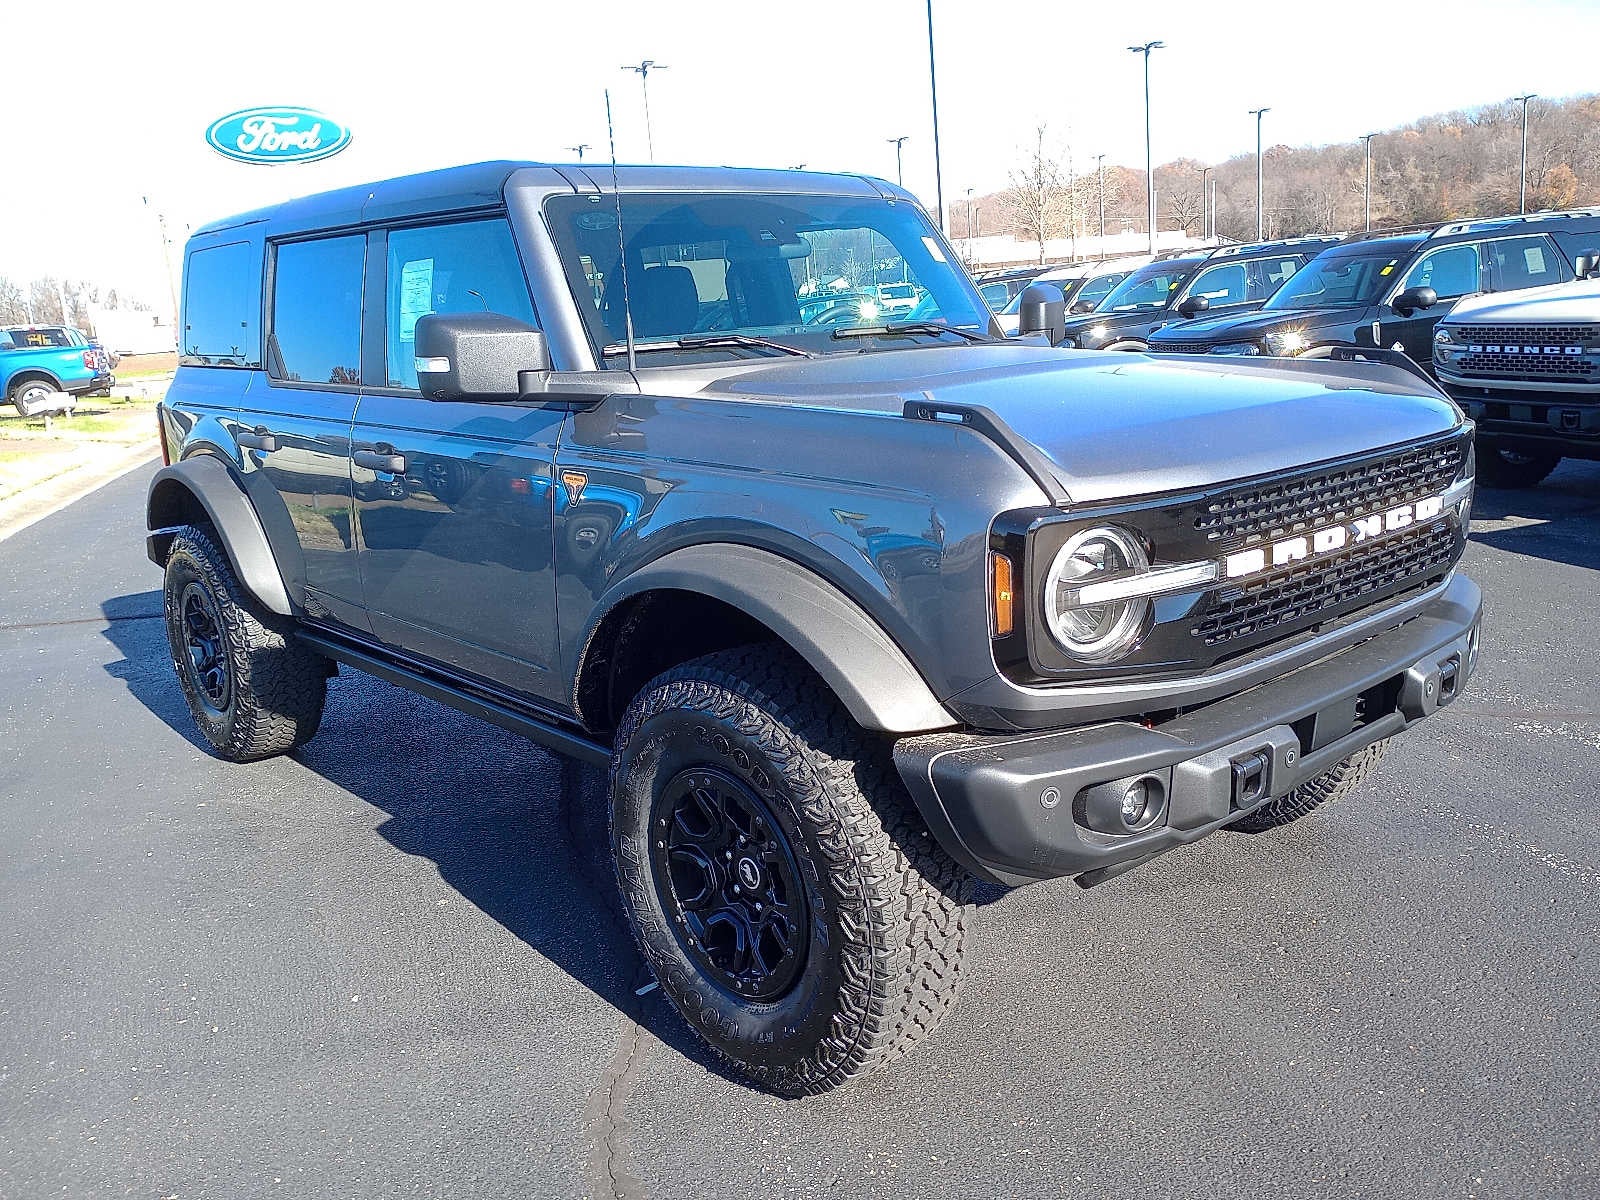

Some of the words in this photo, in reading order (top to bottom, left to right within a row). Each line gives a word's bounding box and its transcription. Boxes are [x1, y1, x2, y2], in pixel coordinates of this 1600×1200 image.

[237, 116, 322, 152] Ford
[1468, 345, 1582, 355] BRONCO
[1225, 496, 1443, 578] BRONCO
